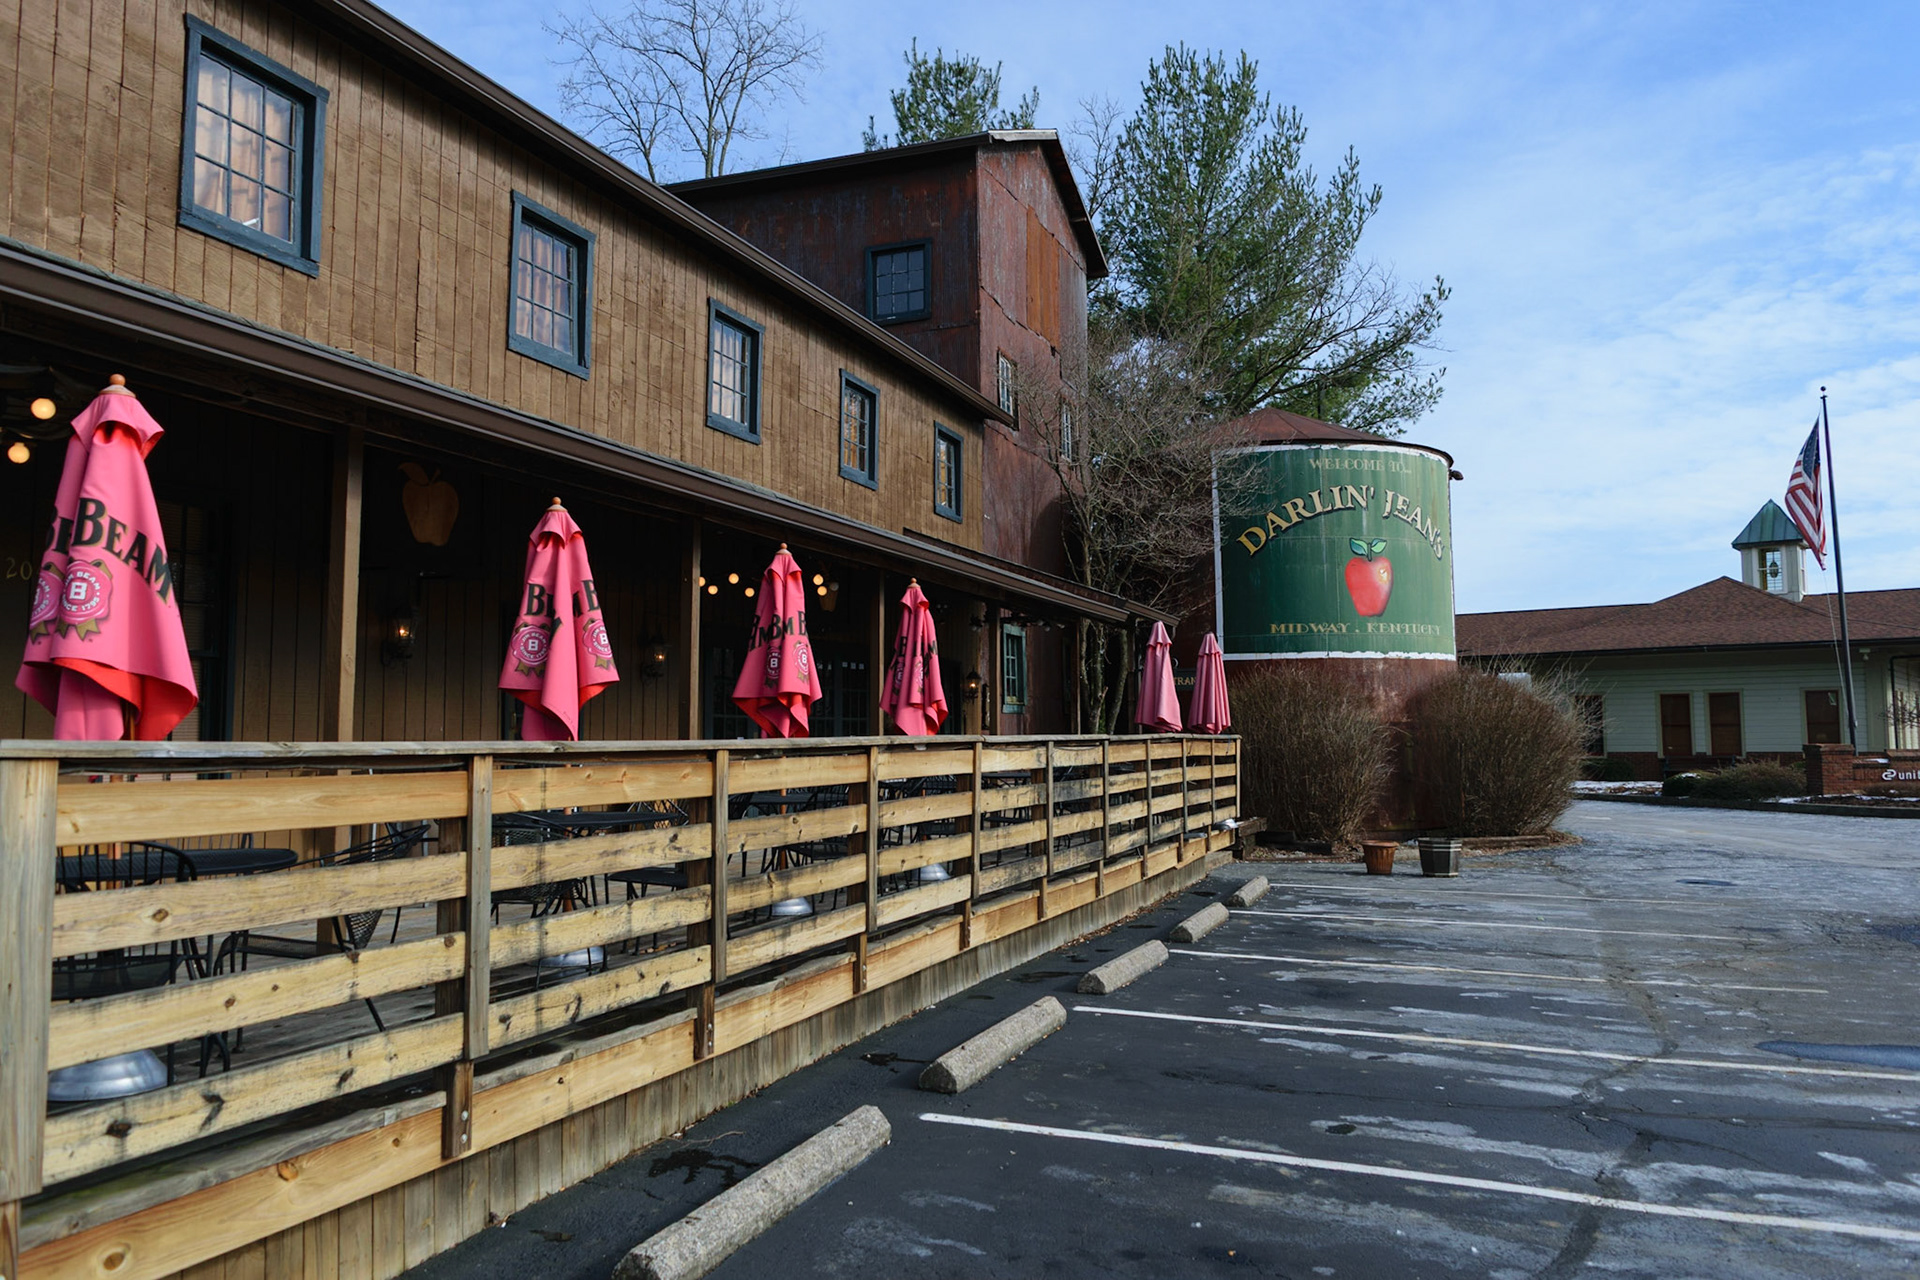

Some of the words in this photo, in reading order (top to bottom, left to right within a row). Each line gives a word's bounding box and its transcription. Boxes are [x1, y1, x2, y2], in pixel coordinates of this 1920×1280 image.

[1309, 458, 1385, 471] WELCOME
[1236, 485, 1375, 556] DARLIN'
[71, 497, 173, 604] BEAM
[77, 571, 101, 590] BEAM
[69, 582, 88, 600] B
[1269, 622, 1350, 634] MIDWAY
[1367, 622, 1441, 635] KENTUCKY
[527, 639, 539, 651] B
